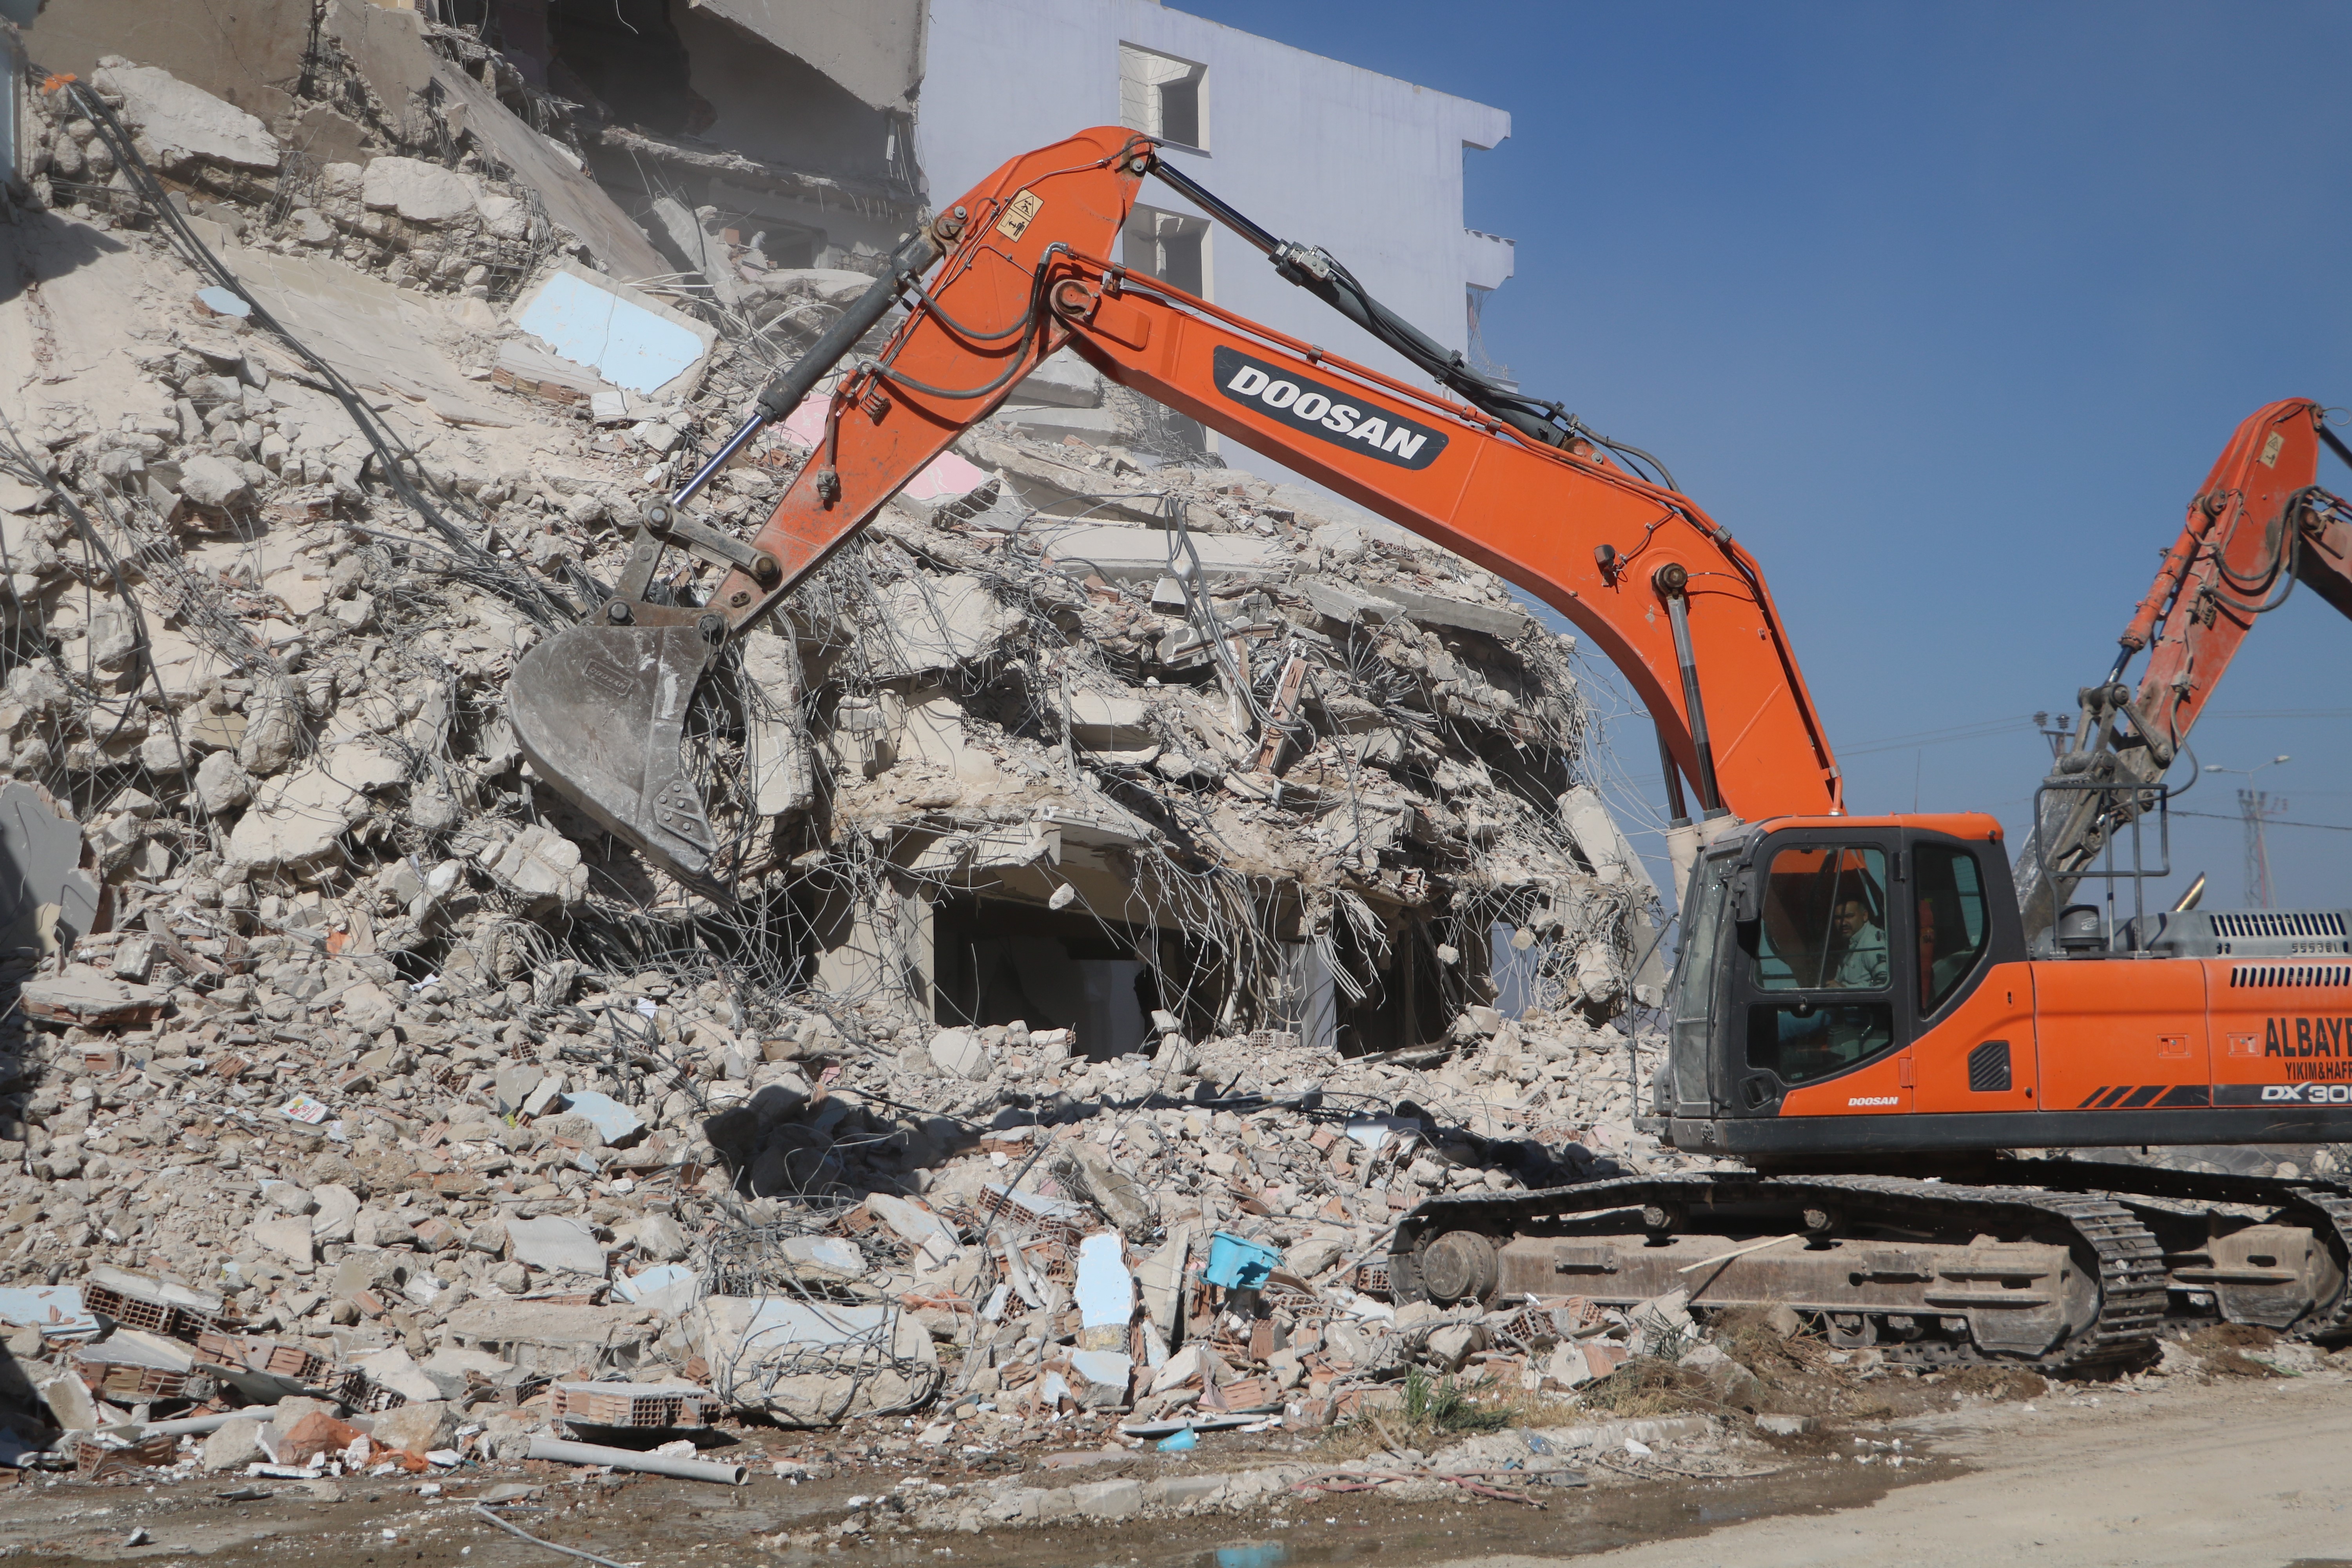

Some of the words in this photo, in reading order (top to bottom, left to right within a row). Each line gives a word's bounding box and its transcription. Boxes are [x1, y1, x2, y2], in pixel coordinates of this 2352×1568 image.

[1227, 365, 1428, 459] DOOSAN
[1848, 1096, 1898, 1106] DOOSAN
[2261, 1081, 2313, 1100] DX
[2308, 1085, 2352, 1103] 30
